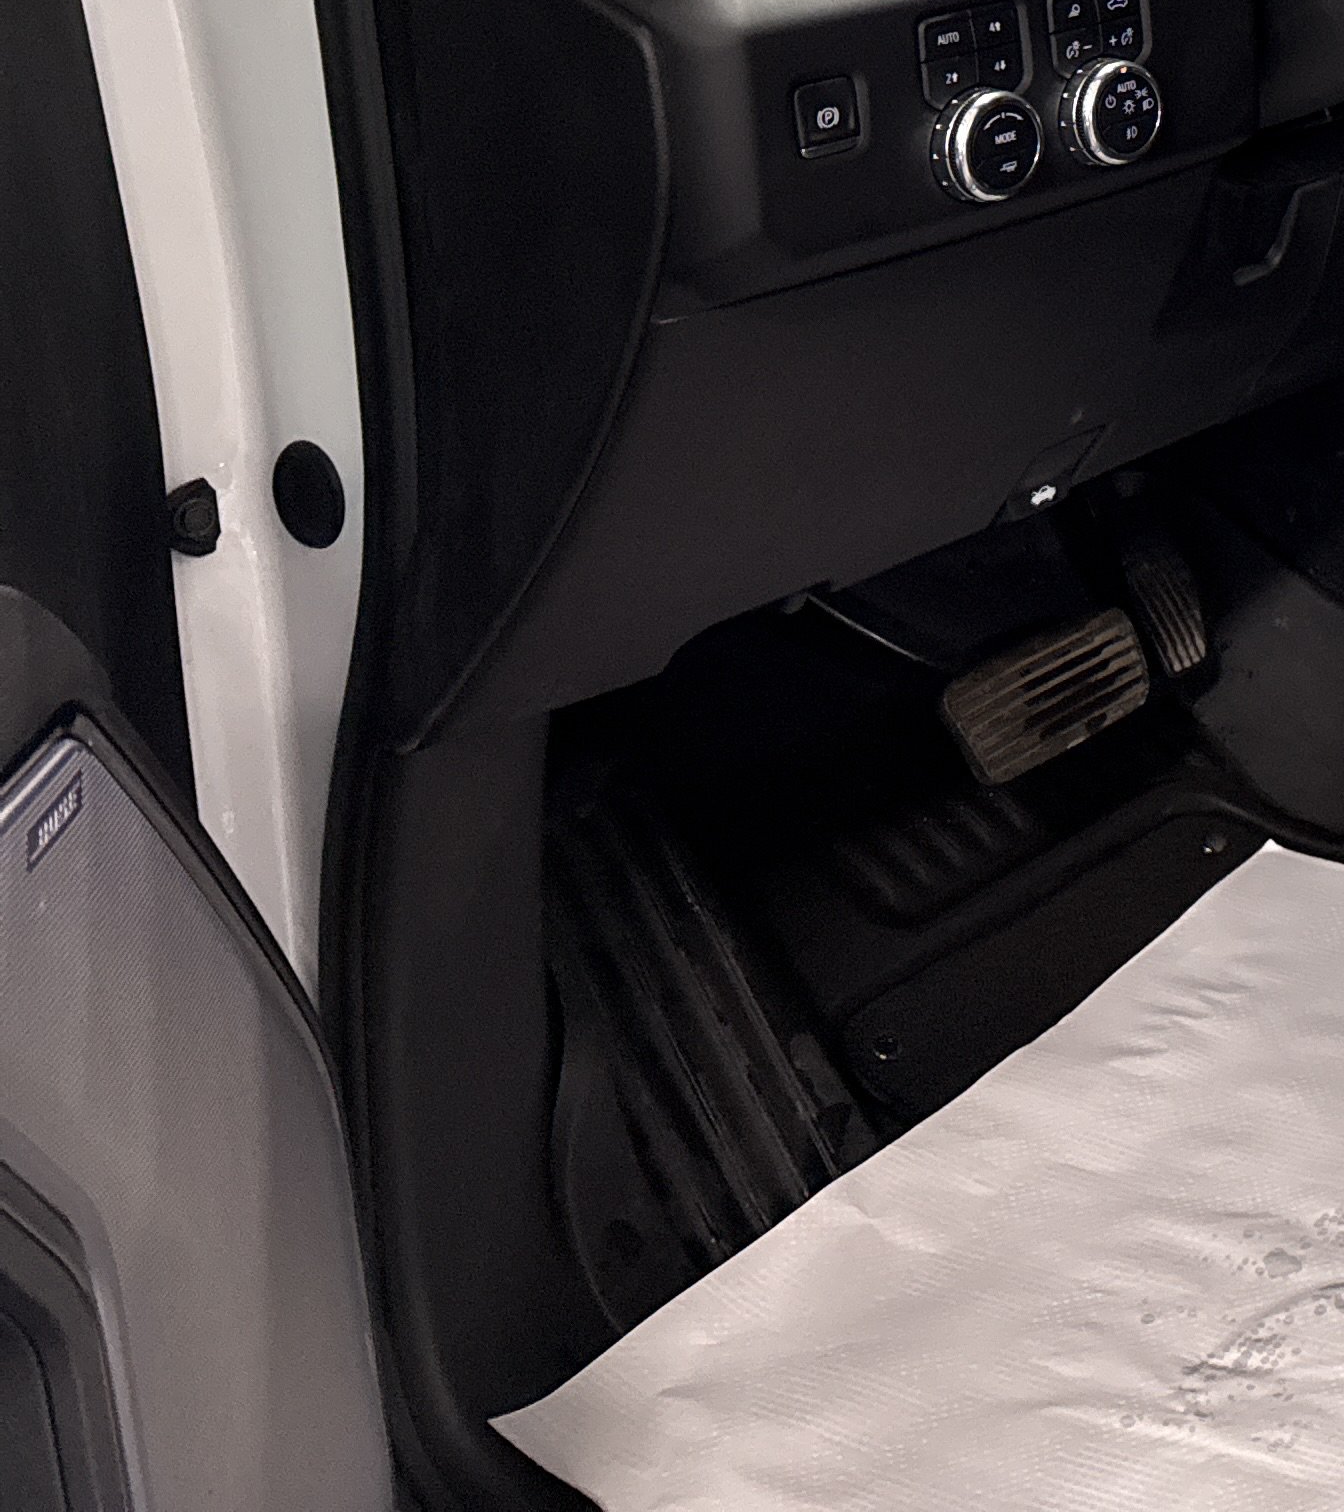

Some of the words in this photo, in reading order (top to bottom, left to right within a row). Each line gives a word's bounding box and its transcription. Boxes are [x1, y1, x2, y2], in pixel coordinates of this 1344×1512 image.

[937, 31, 960, 47] AUTO
[1116, 80, 1137, 94] AUTO
[994, 130, 1017, 145] MODE
